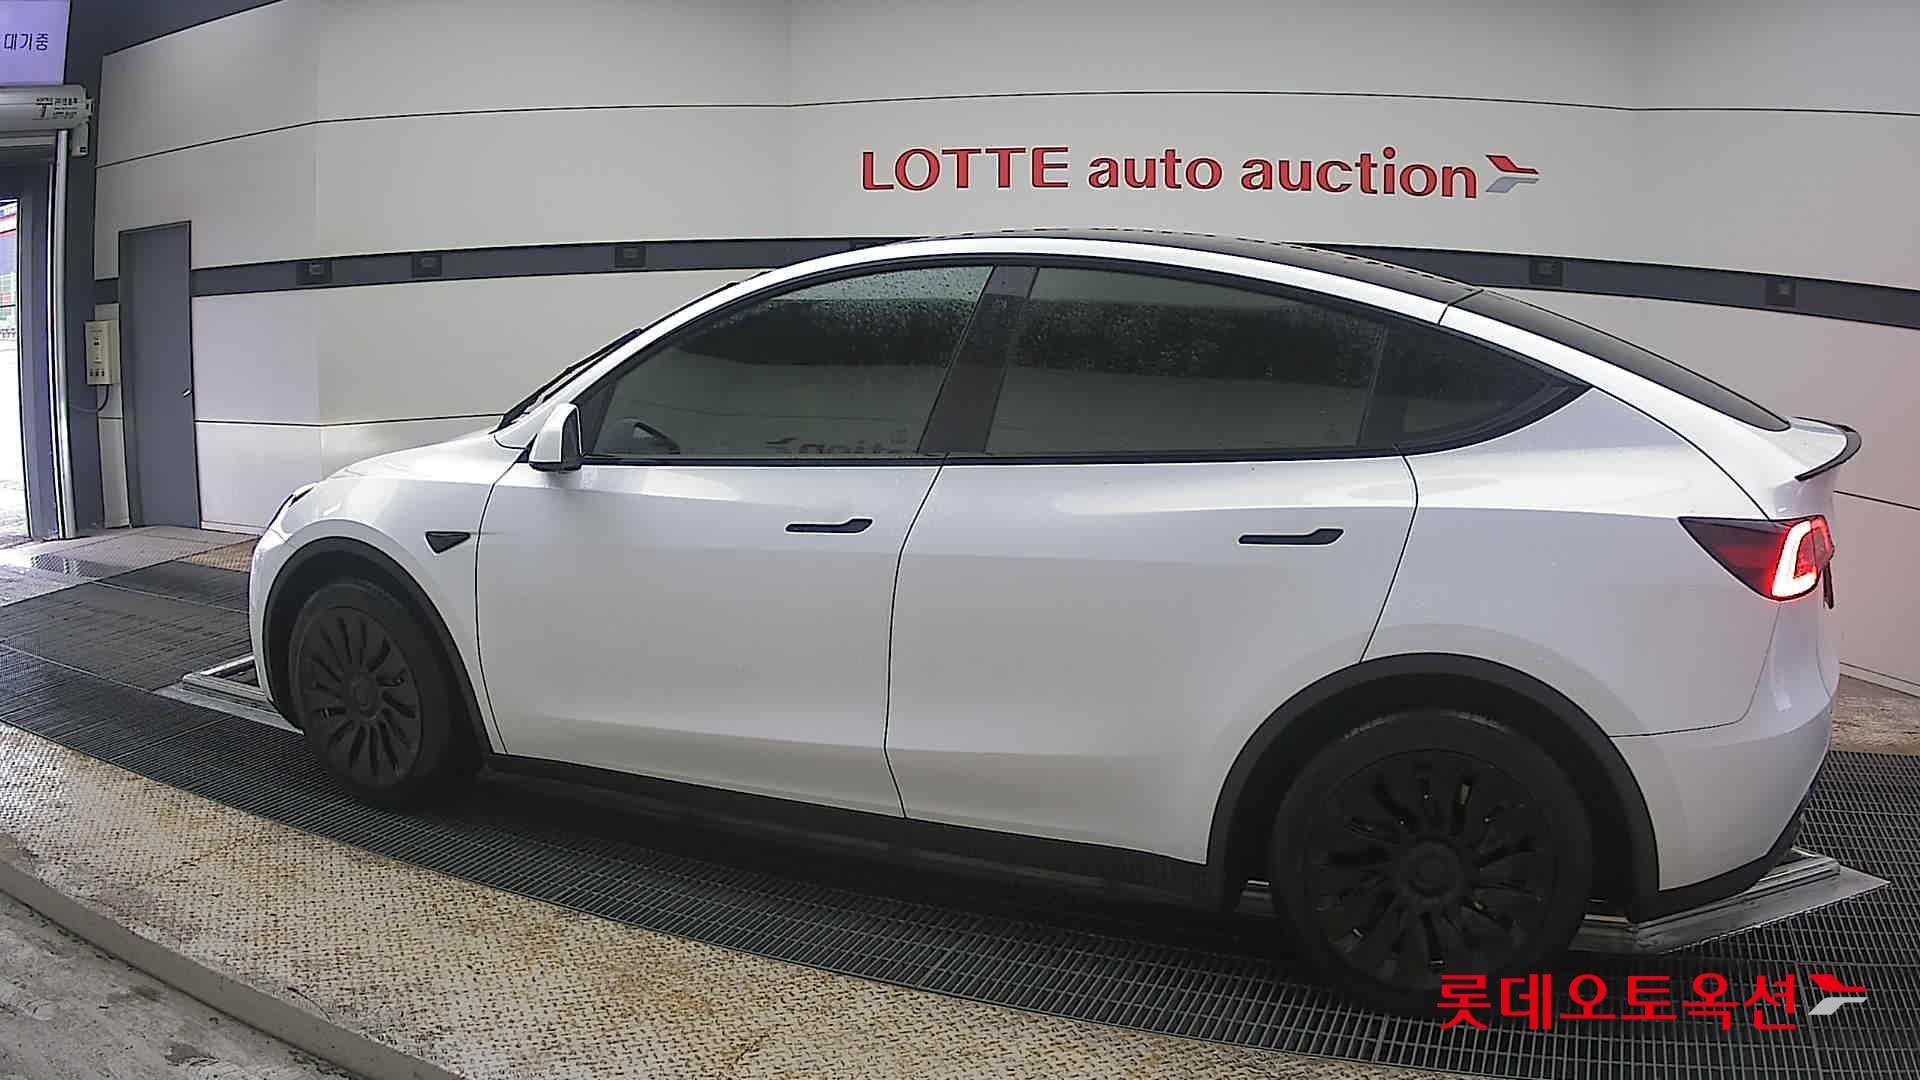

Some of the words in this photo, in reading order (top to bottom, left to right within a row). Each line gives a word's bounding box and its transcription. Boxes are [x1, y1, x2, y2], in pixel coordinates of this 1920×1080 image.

[4, 33, 49, 51] 대기중
[862, 147, 1069, 191] LOTTE
[1088, 148, 1223, 190] auto
[1240, 146, 1477, 199] auction
